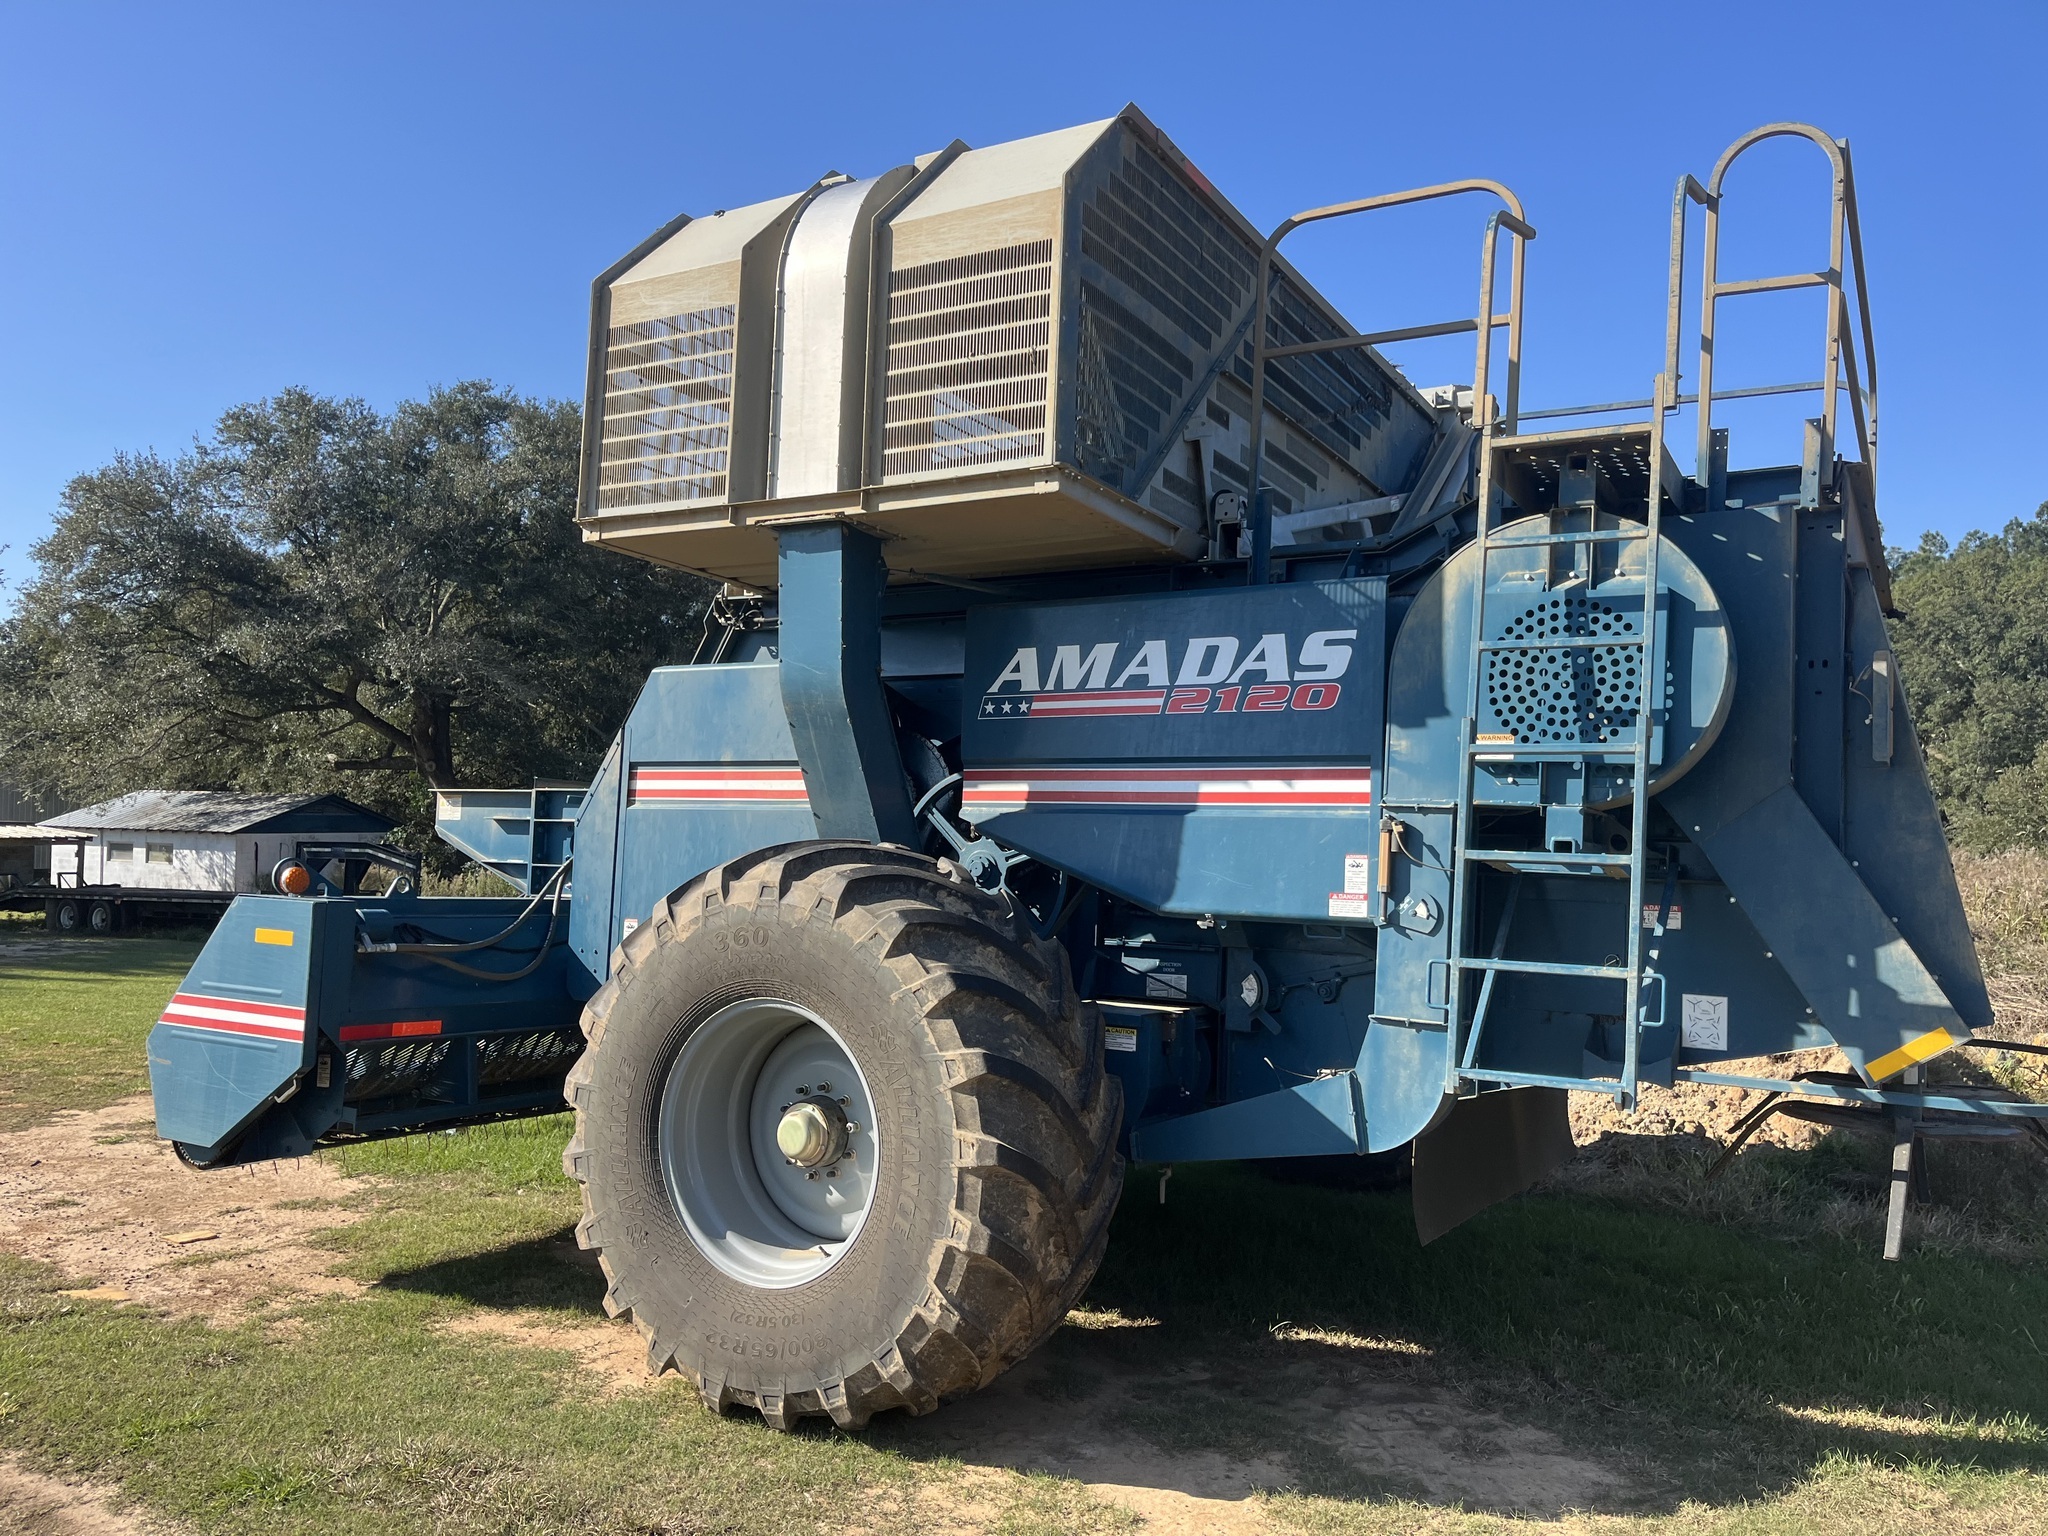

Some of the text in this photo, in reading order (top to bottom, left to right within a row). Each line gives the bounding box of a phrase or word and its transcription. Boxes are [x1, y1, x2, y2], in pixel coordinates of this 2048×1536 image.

[986, 629, 1358, 693] AMADAS
[1164, 682, 1341, 715] 2120
[714, 926, 769, 953] 360
[609, 1055, 644, 1217] ALLIANCE
[880, 1059, 921, 1241] ALLIANCE
